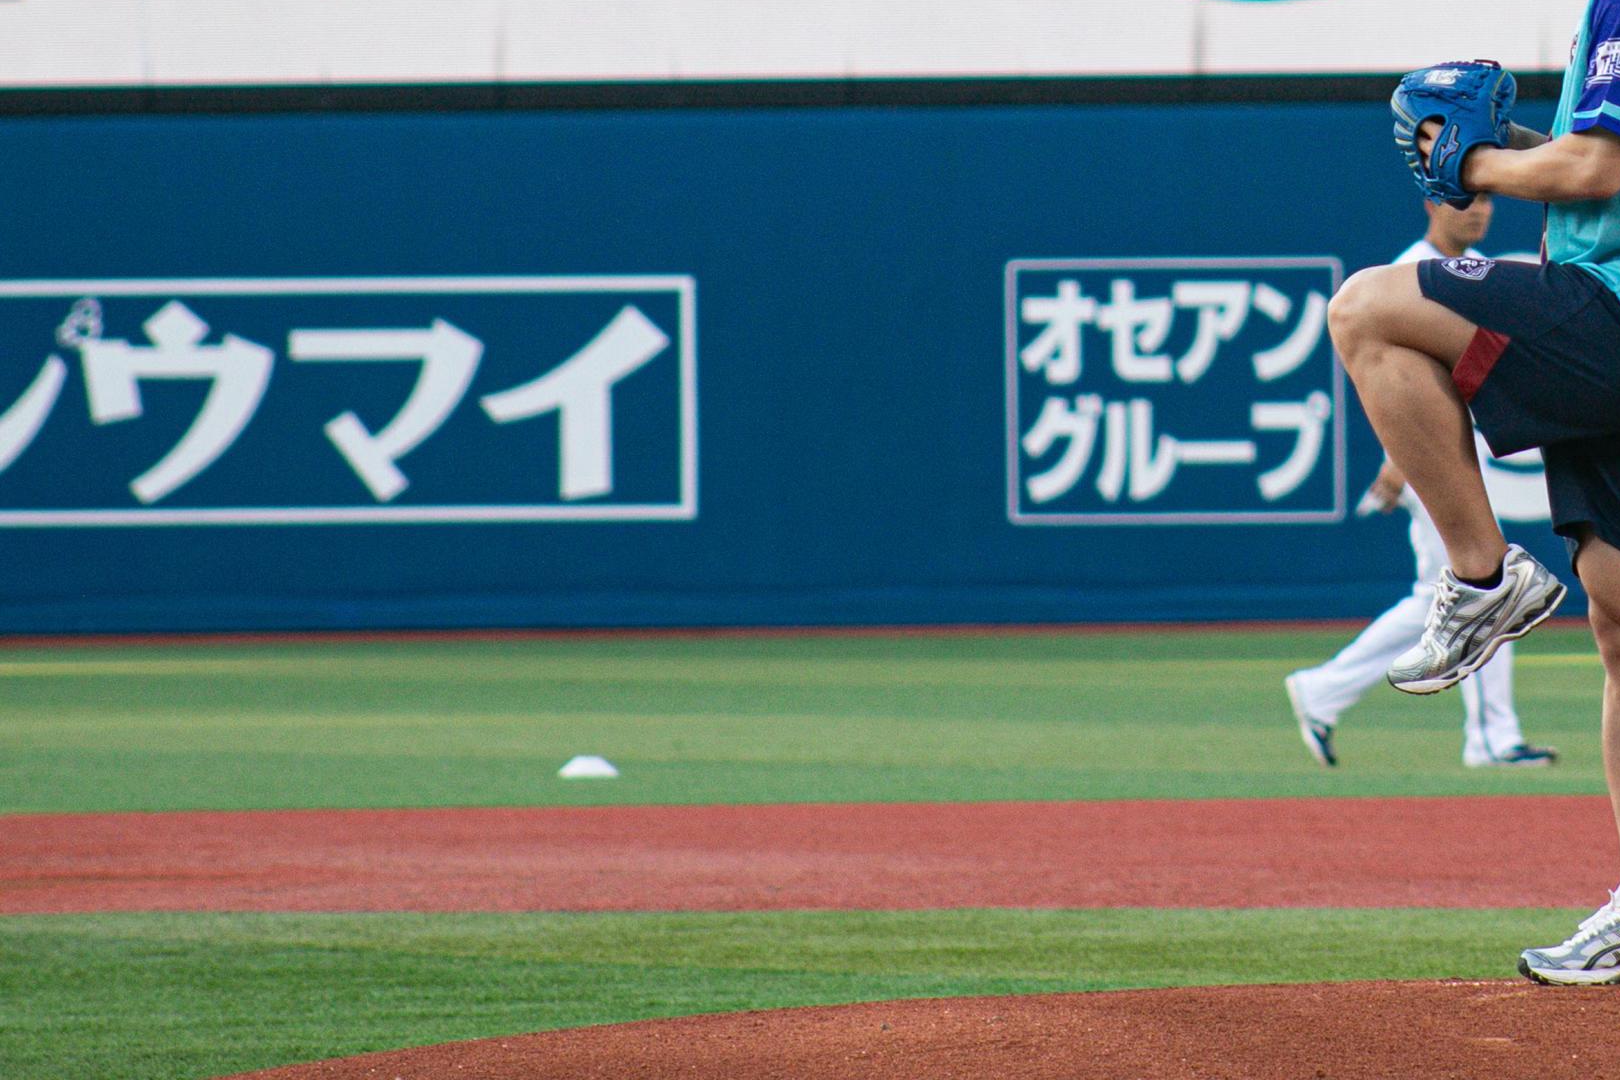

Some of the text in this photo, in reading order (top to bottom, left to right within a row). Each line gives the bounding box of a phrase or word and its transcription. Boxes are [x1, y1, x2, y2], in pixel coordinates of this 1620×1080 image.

[1021, 279, 1328, 385] オセアン
[1022, 390, 1332, 503] グループ
